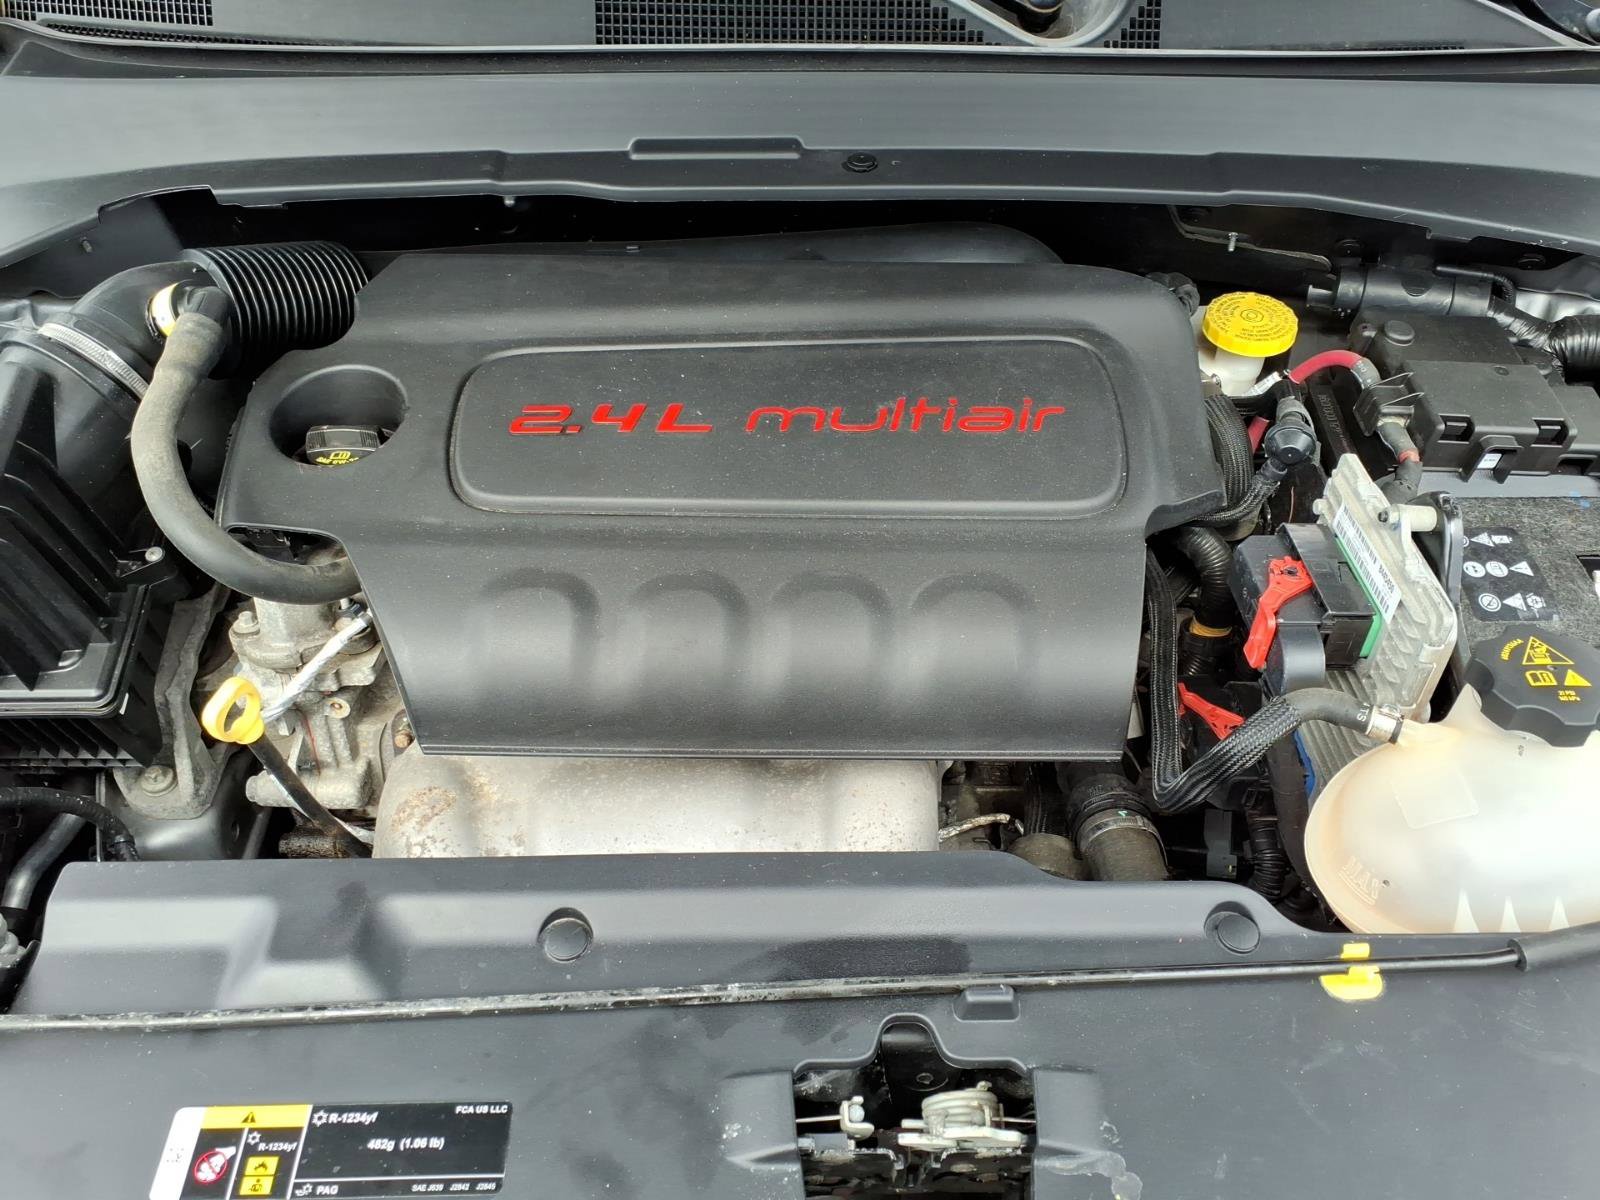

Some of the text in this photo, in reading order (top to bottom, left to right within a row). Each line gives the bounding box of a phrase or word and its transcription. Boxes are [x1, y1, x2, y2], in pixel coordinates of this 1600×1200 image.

[508, 396, 1066, 437] 2.4L multiair
[455, 1105, 508, 1114] FCA US LLC
[328, 1111, 379, 1125] R-1234yf
[257, 1142, 297, 1152] R-1234yf
[366, 1138, 395, 1152] 482g
[429, 1136, 445, 1150] lb)
[316, 1185, 338, 1195] PAG
[411, 1184, 427, 1192] SAE
